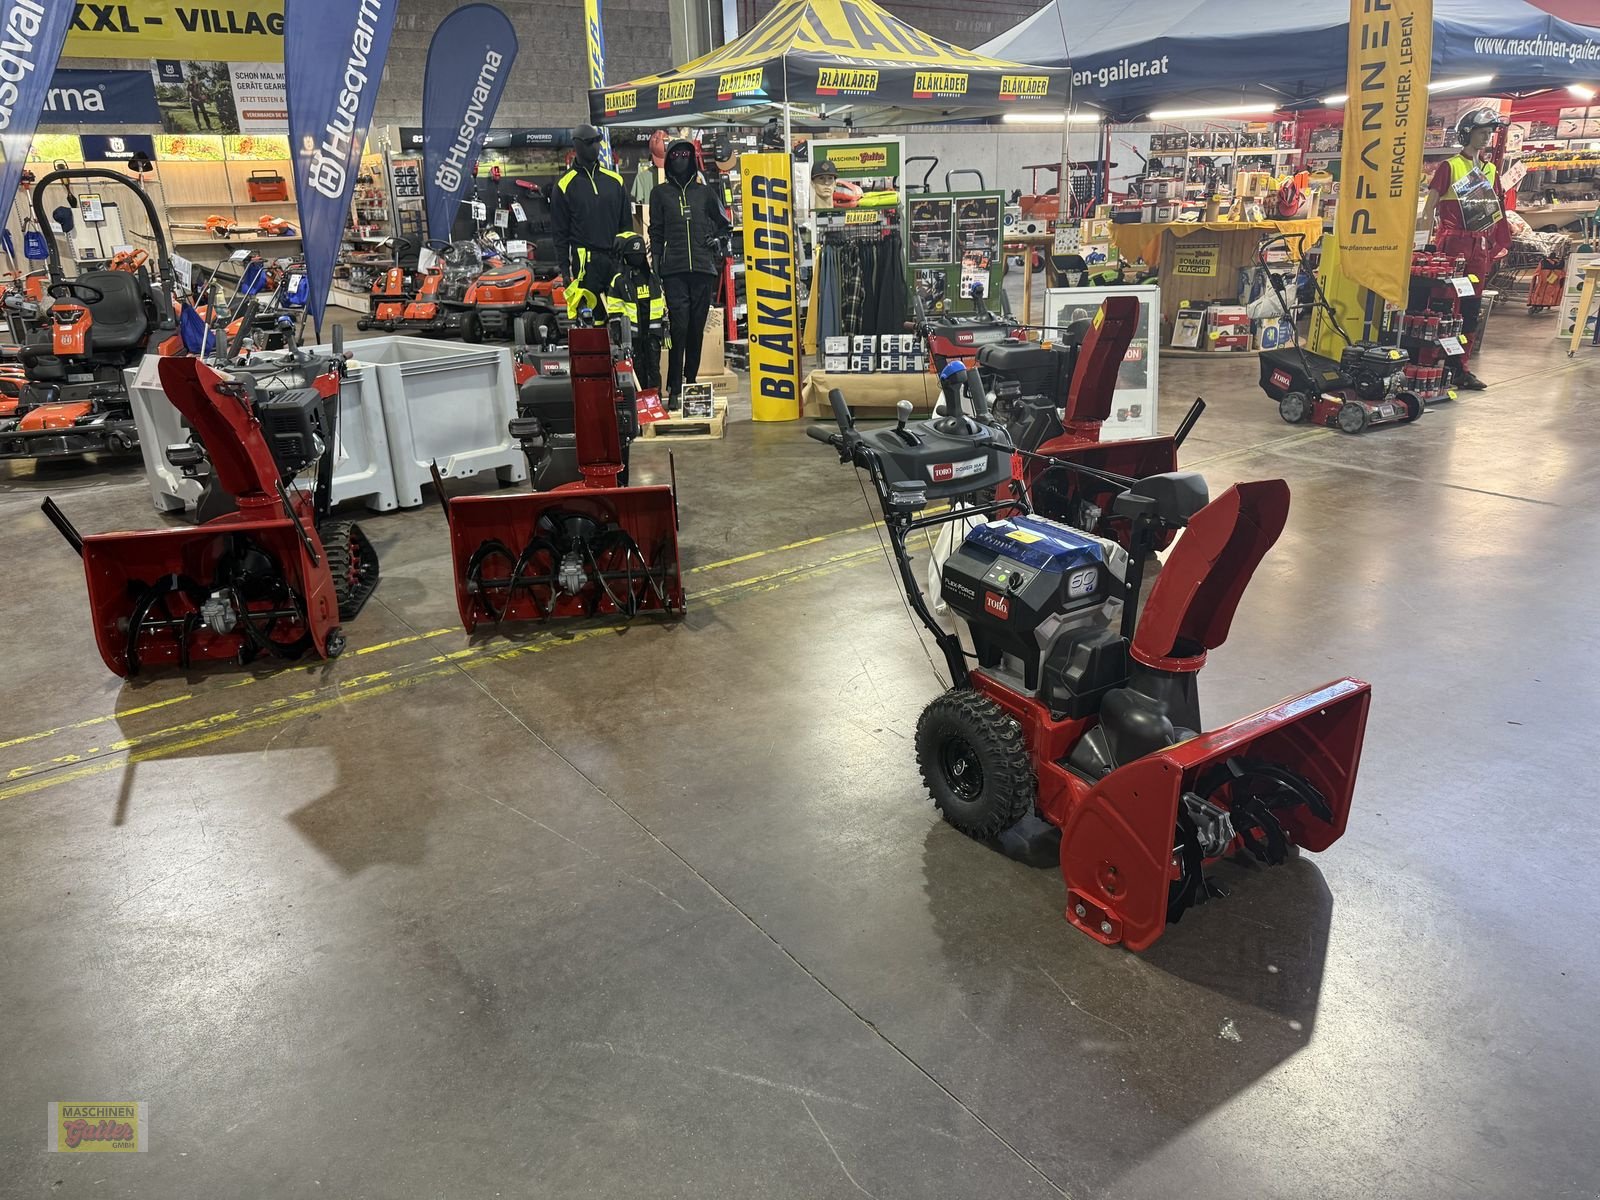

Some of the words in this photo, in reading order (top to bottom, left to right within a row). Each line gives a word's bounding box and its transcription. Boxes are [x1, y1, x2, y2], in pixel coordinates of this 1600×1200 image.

[1400, 11, 1414, 64] LEBEN.
[235, 72, 259, 80] SCHON
[719, 70, 762, 93] BLÅKLÄDER
[819, 70, 878, 89] BLÅKLÄDER
[915, 73, 967, 92] BLÅKLÄDER
[1001, 76, 1048, 94] BLÅKLÄDER
[237, 82, 263, 90] GERÄTE
[659, 82, 694, 103] BLÅKLÄDER
[606, 92, 636, 110] BLÅKLÄDER
[1394, 69, 1412, 127] SICHER.
[445, 50, 503, 170] Husqvarna
[1389, 131, 1408, 198] EINFACH.
[1178, 265, 1210, 273] KRACHER
[1179, 258, 1211, 266] SOMMER
[747, 174, 795, 401] BLÅKLÄDER
[1126, 350, 1139, 359] ON
[1273, 373, 1291, 387] TORO
[935, 467, 952, 477] TORO
[1071, 570, 1097, 589] 60
